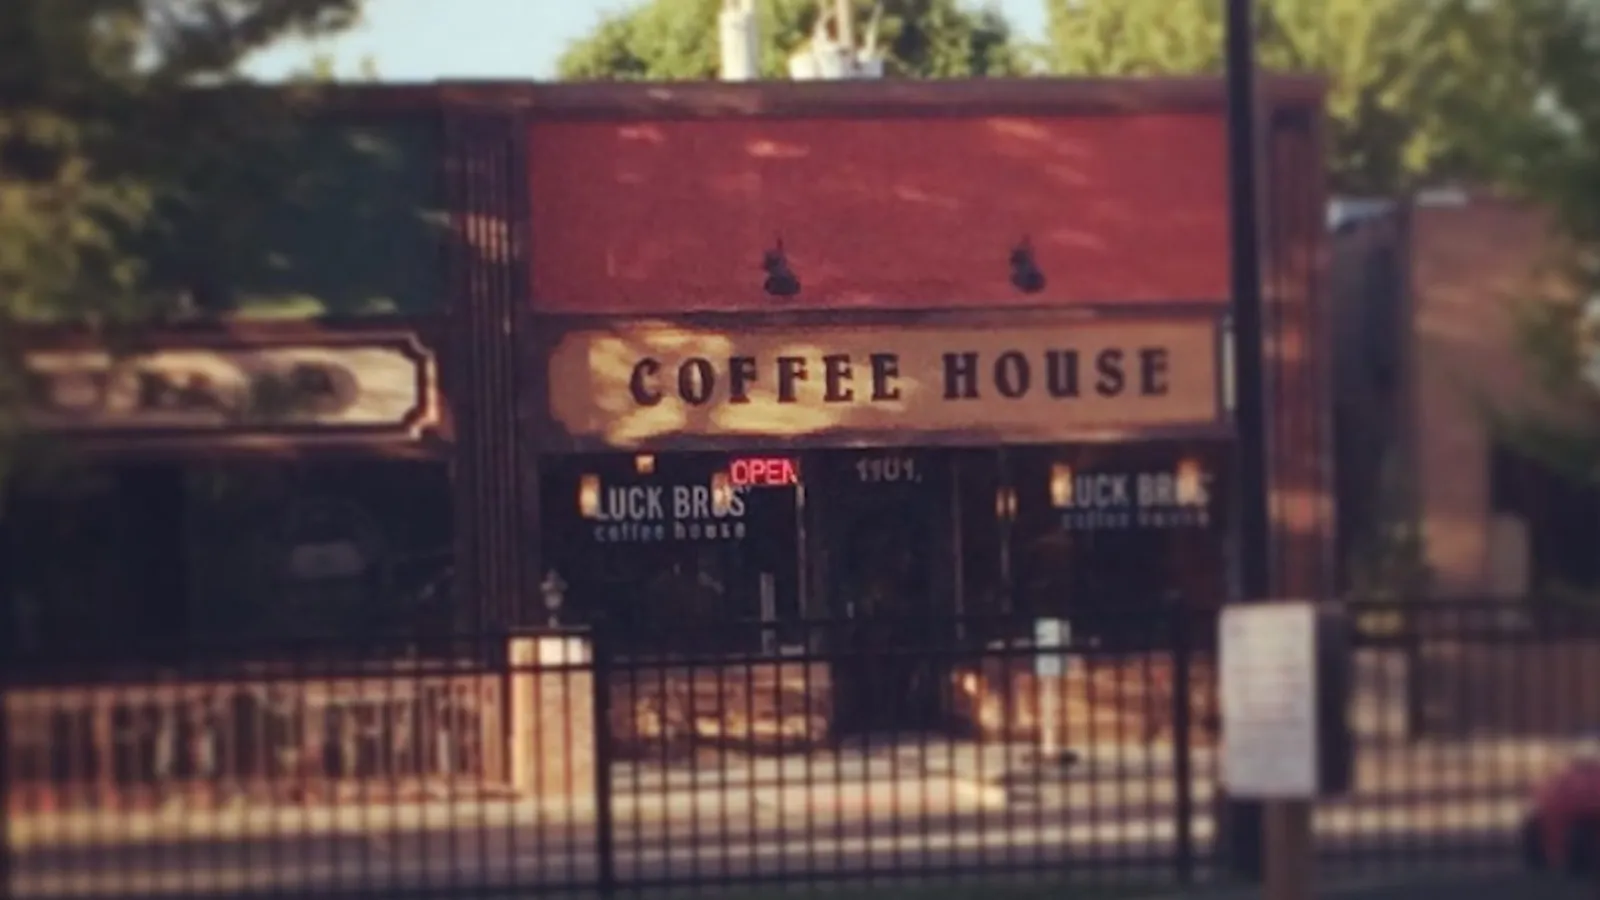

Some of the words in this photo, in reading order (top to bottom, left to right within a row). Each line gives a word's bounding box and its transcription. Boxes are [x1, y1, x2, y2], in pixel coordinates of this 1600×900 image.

[629, 353, 901, 406] COFFEE
[942, 348, 1169, 400] HOUSE
[730, 459, 797, 485] OPEN
[594, 486, 664, 520] LUCK
[674, 521, 746, 540] house
